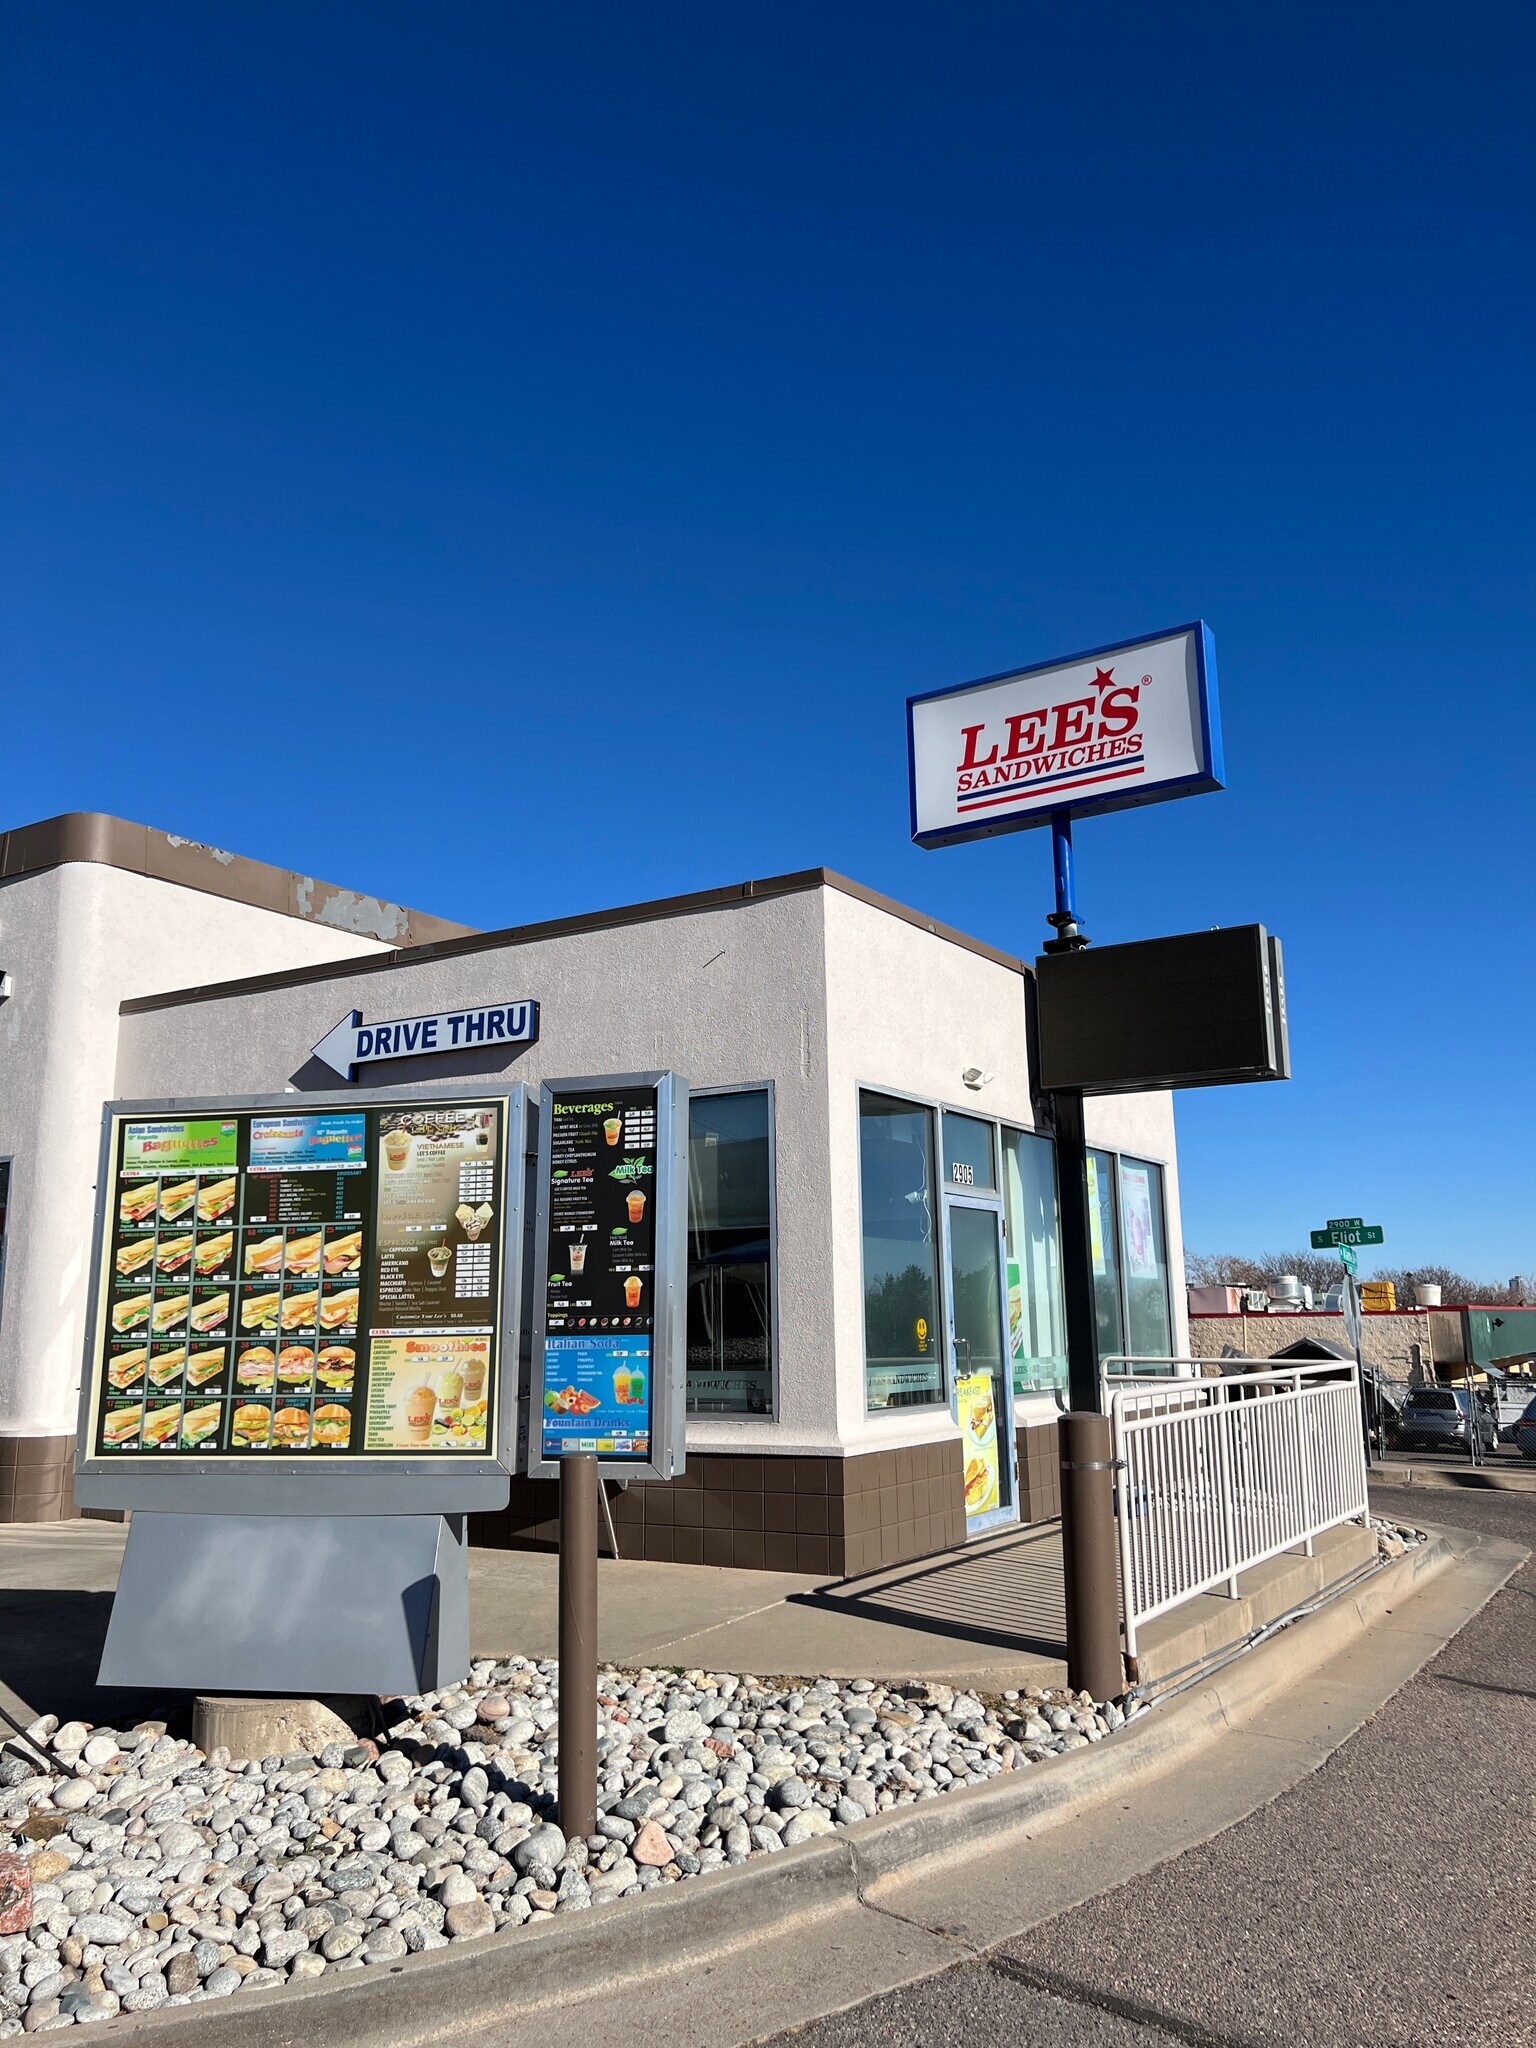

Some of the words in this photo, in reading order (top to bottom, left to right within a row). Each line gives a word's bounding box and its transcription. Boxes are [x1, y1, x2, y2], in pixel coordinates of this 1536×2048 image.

[956, 732, 1143, 793] SANDWICHES
[356, 1019, 438, 1058] DRIVE
[447, 1006, 527, 1045] THRU
[553, 1102, 614, 1115] Beverages
[253, 1120, 281, 1128] European
[400, 1112, 466, 1125] COFFEE
[128, 1126, 145, 1134] Asian
[147, 1124, 184, 1133] Sandwiches
[253, 1129, 304, 1140] Croissants
[142, 1137, 218, 1153] Baguettes
[309, 1134, 362, 1146] Baguettes
[417, 1142, 465, 1150] VIETNAMESE
[616, 1165, 635, 1175] Milk
[637, 1165, 654, 1174] Tea
[953, 1163, 973, 1184] 2905
[551, 1177, 581, 1186] Signature
[1328, 1220, 1350, 1229] 2900
[1353, 1219, 1361, 1227] W
[1317, 1235, 1323, 1243] S
[1331, 1230, 1362, 1245] Eliot
[1367, 1231, 1376, 1239] St
[152, 1343, 159, 1351] 14
[405, 1339, 488, 1353] Smoothies
[547, 1338, 586, 1349] Italian
[589, 1337, 620, 1349] Soda
[545, 1418, 592, 1429] Fountain
[593, 1418, 631, 1428] Drinks
